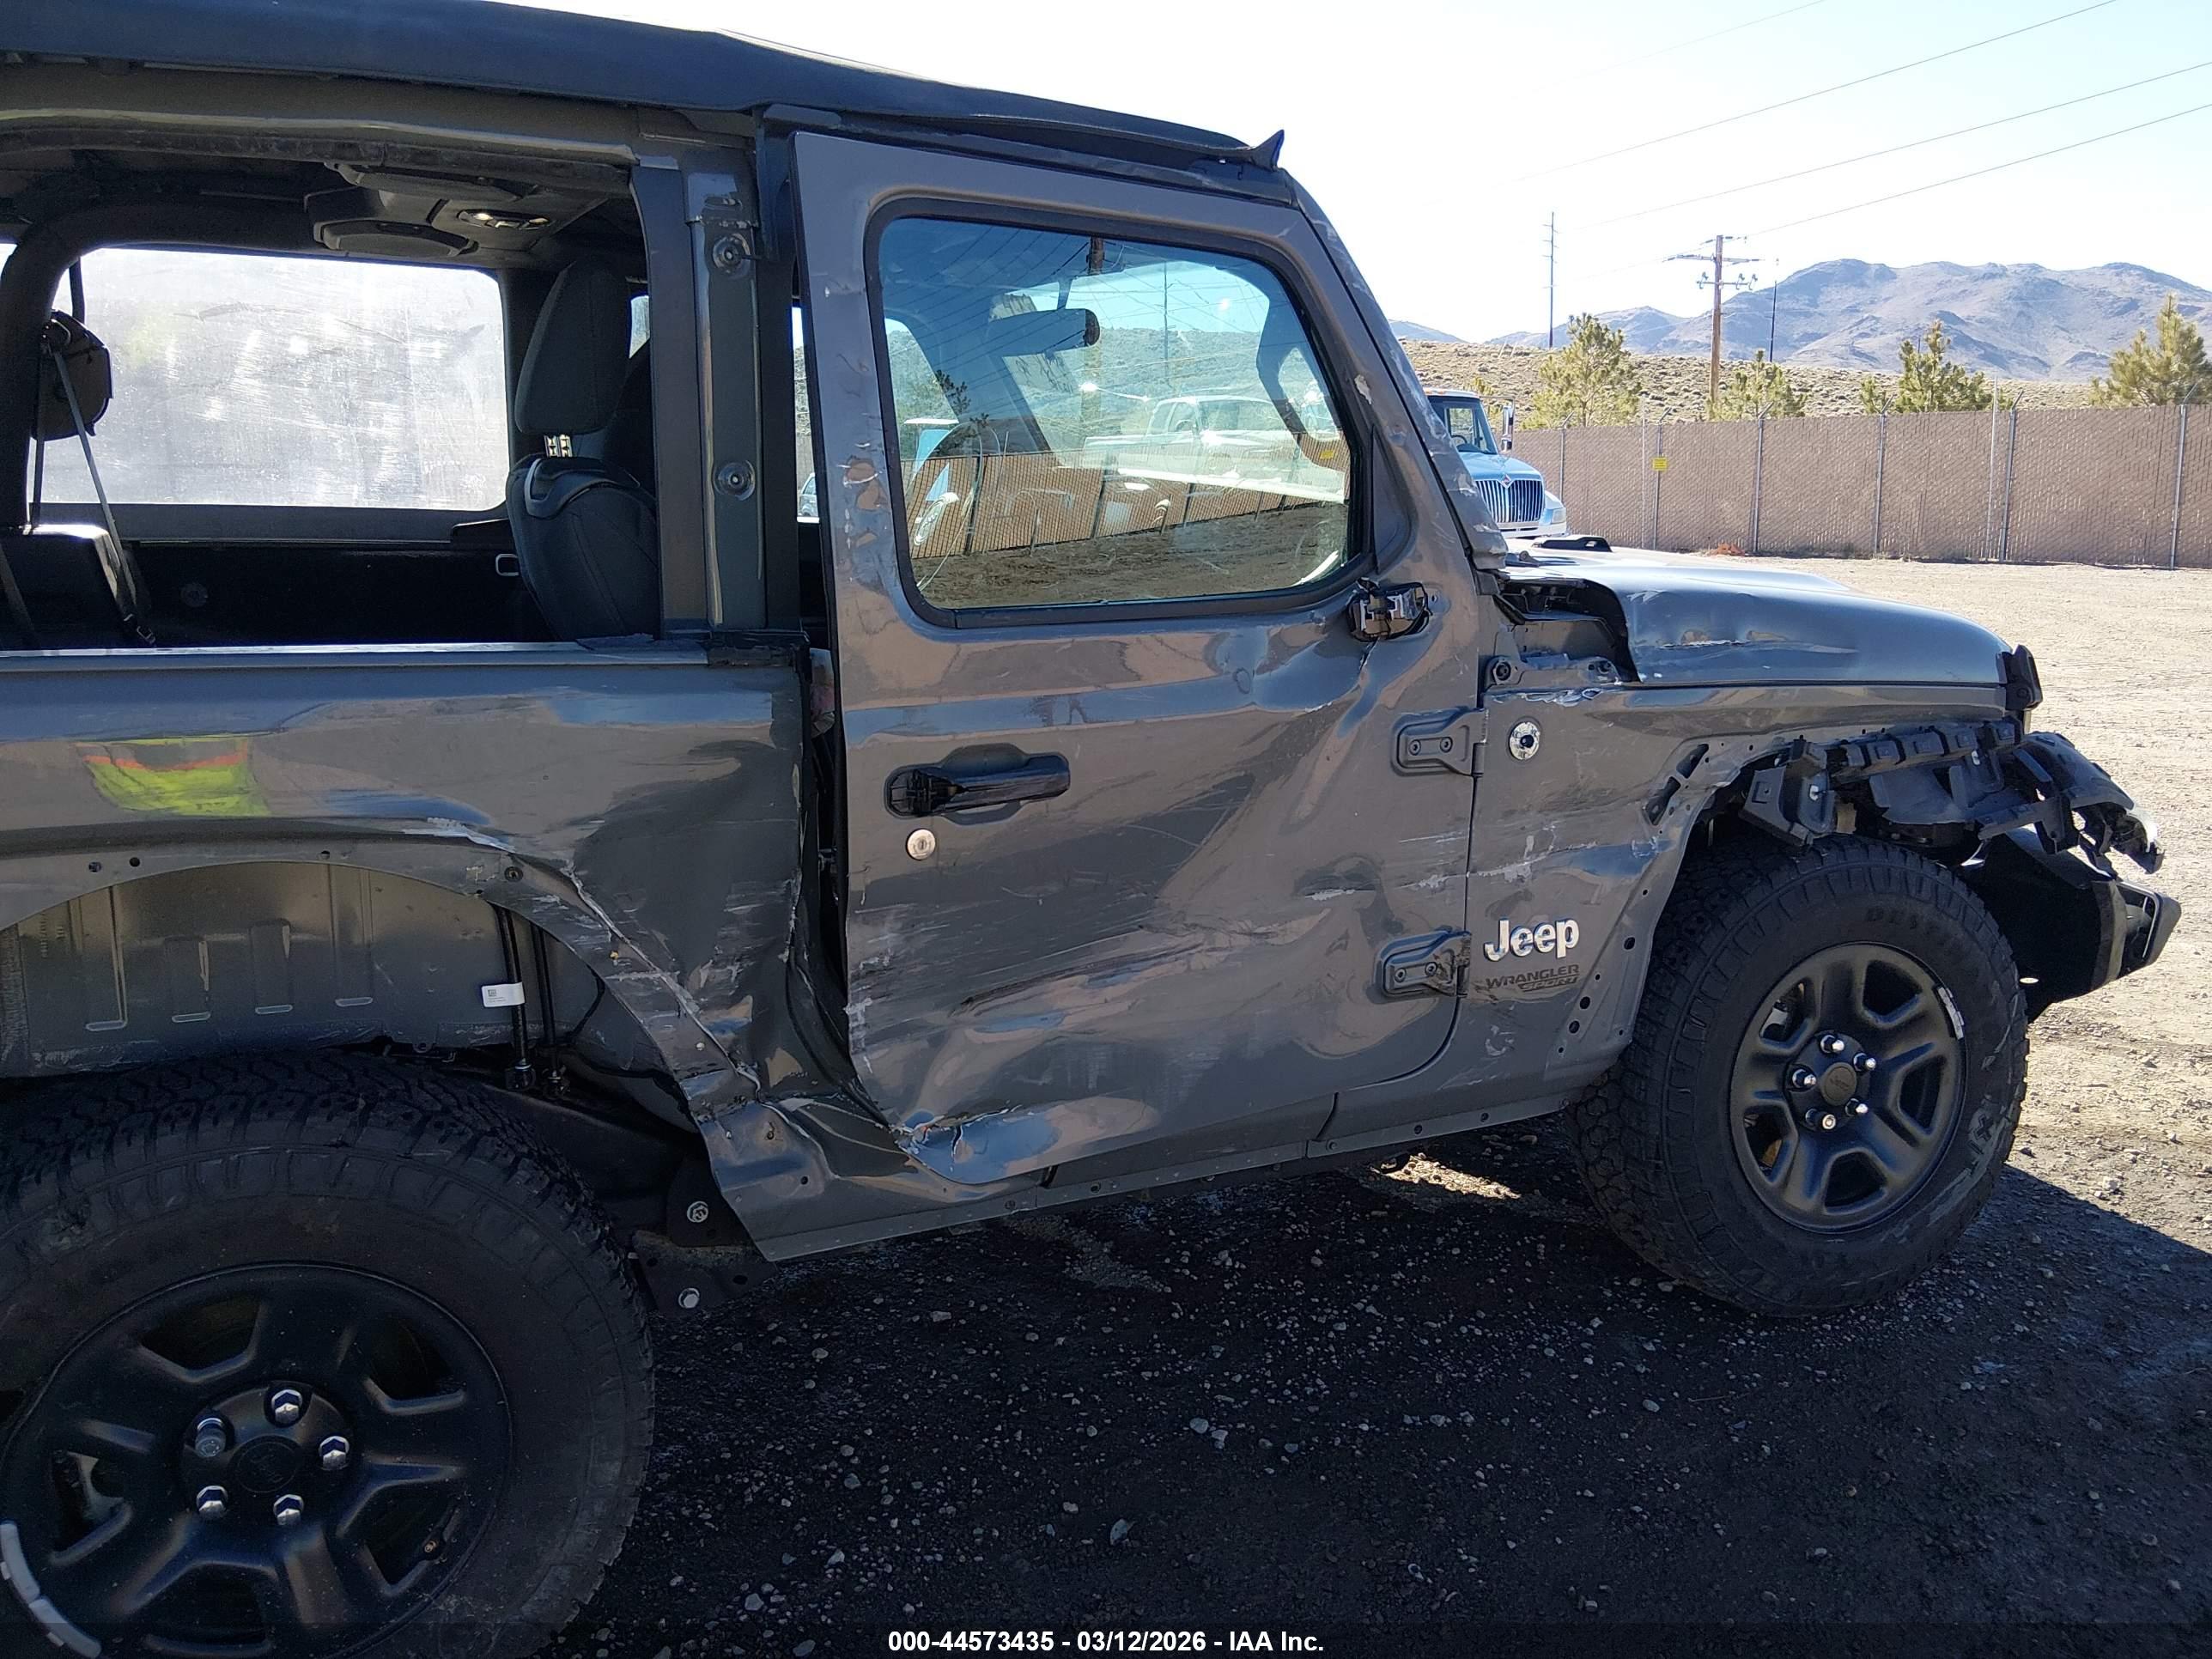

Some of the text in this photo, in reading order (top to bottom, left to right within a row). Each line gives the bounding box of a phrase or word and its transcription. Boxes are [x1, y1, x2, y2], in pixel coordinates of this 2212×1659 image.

[1485, 918, 1579, 961] Jeep
[1486, 964, 1579, 988] WRANGLER
[1518, 976, 1578, 992] SPORT
